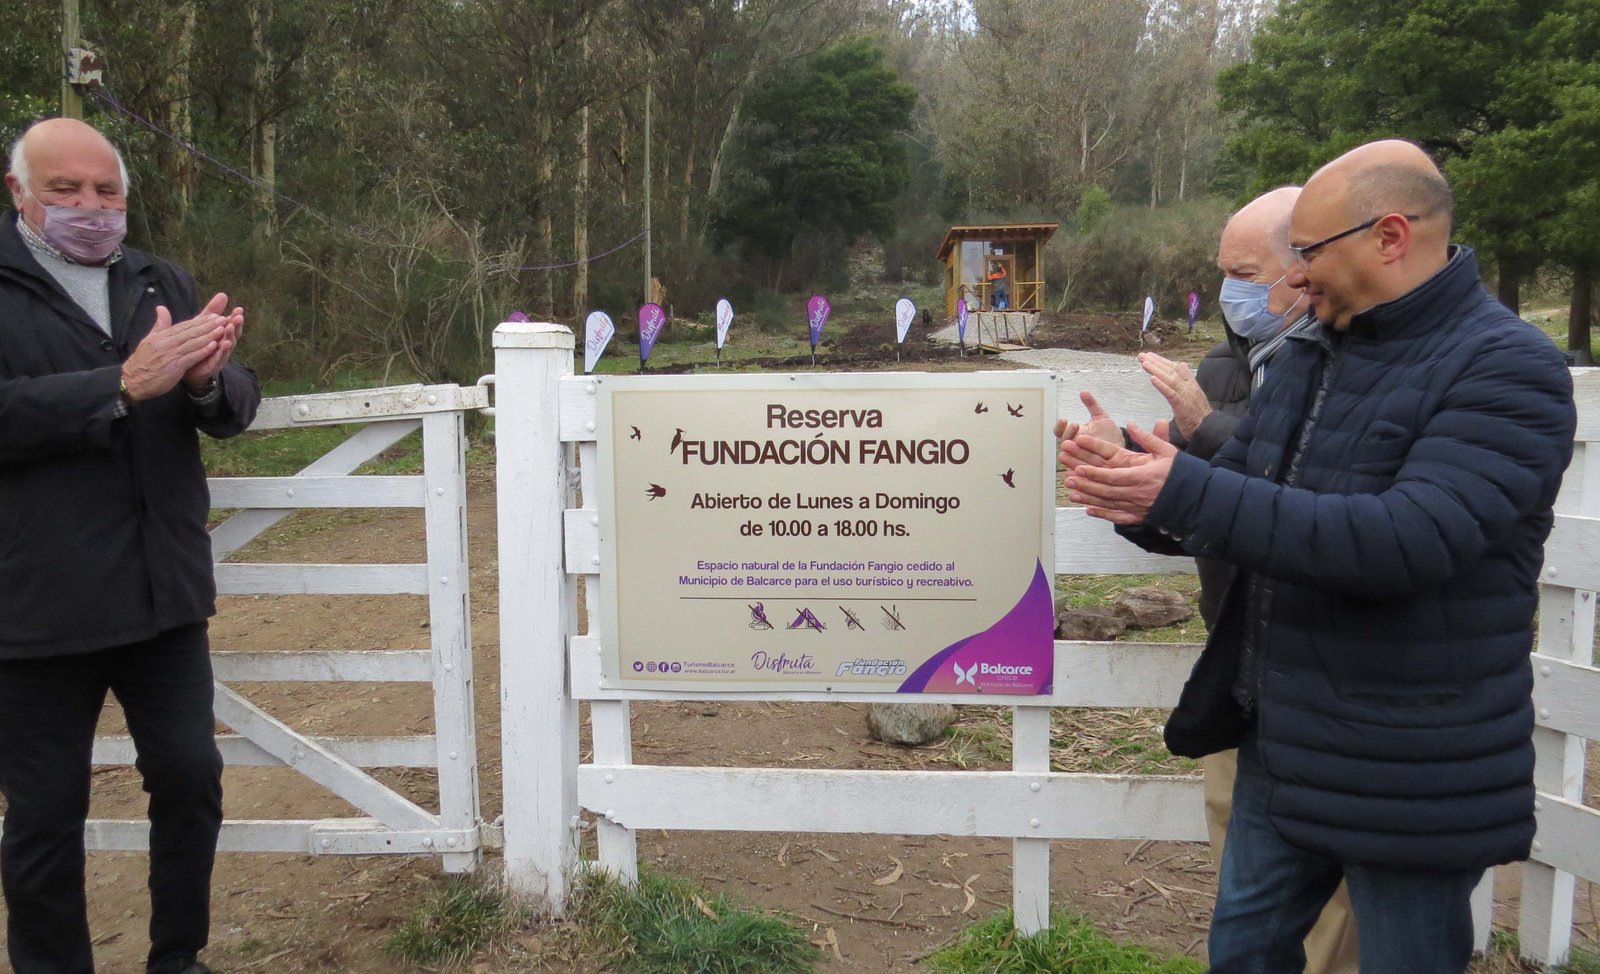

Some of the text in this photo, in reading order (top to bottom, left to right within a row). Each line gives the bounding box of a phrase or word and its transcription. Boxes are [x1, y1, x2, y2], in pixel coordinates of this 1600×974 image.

[767, 404, 882, 428] Reserva
[682, 433, 969, 465] FUNDACIÓN FANGIO
[691, 493, 960, 514] Abierto de Lunes a Domingo
[740, 520, 910, 537] de 10.00 a 18.00 hs.
[697, 560, 955, 574] Espacio natural de la Fundación Fangio cedido al
[679, 575, 974, 589] Municipio de Balcarce para el uso turístico y recreativo.
[751, 650, 815, 673] Disfruta
[835, 662, 907, 677] Fangio
[853, 658, 904, 666] Fundación
[980, 663, 1033, 675] Balcarce
